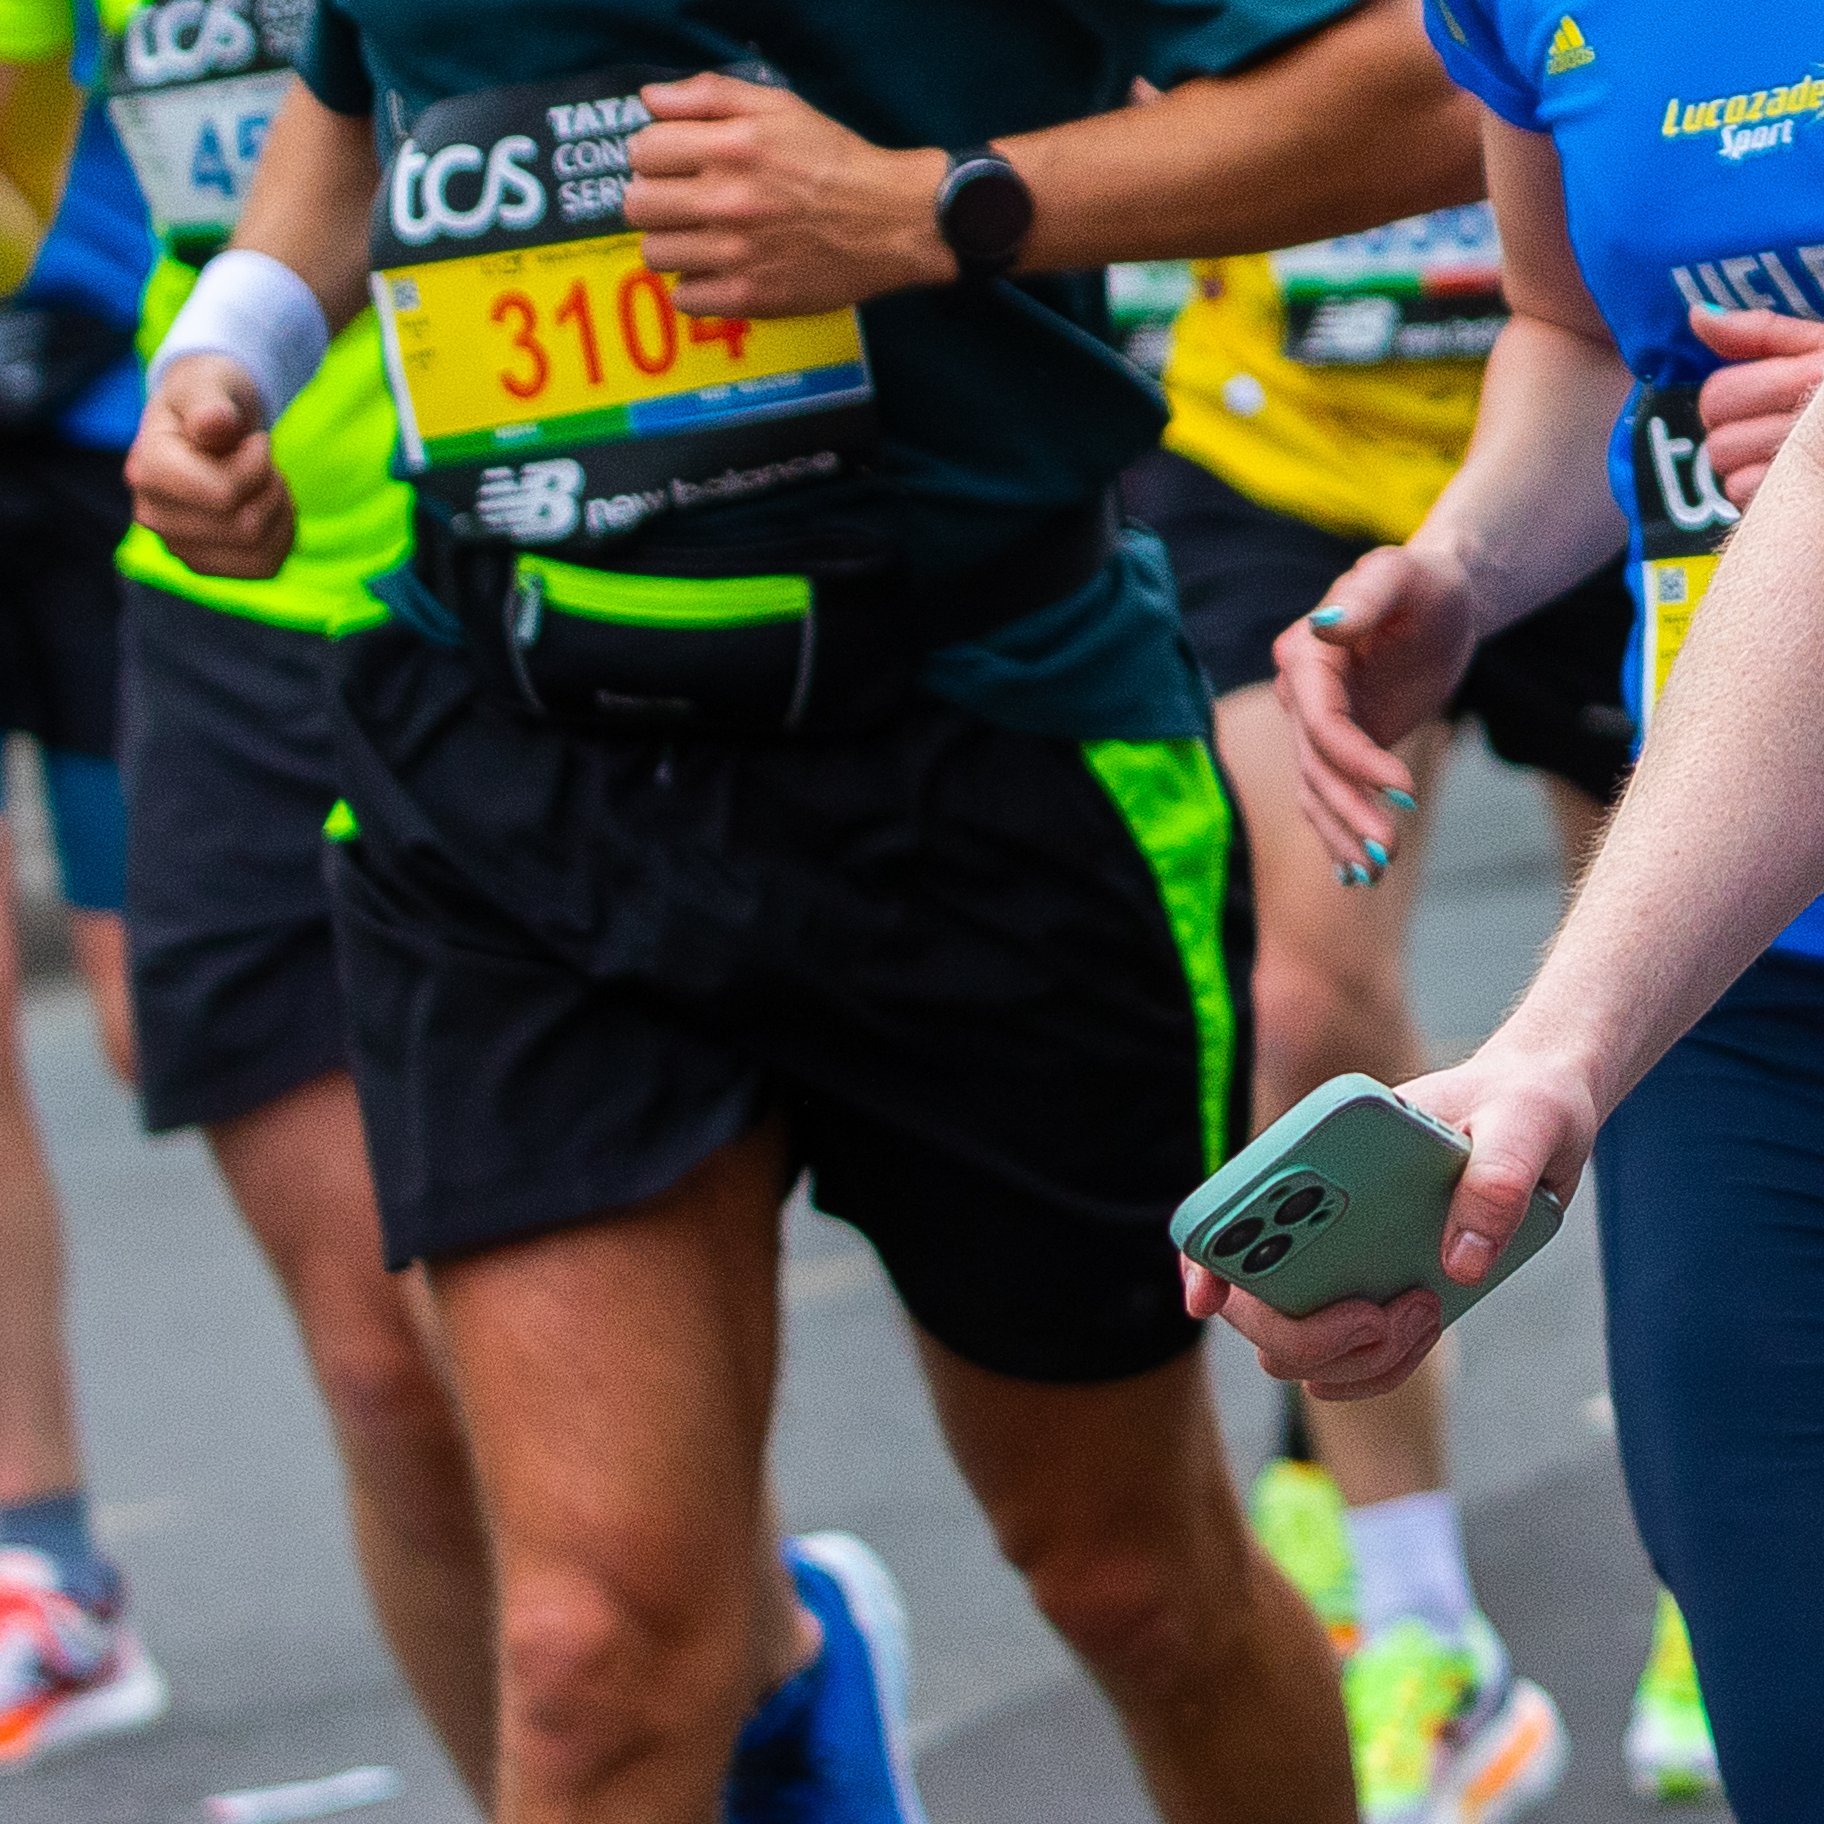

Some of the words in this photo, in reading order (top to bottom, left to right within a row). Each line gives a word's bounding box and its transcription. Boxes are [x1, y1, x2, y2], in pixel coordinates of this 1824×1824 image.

[546, 94, 652, 139] TATA
[1718, 118, 1794, 161] Sport
[390, 134, 548, 247] tcs
[1648, 416, 1743, 530] tc
[585, 487, 668, 538] new
